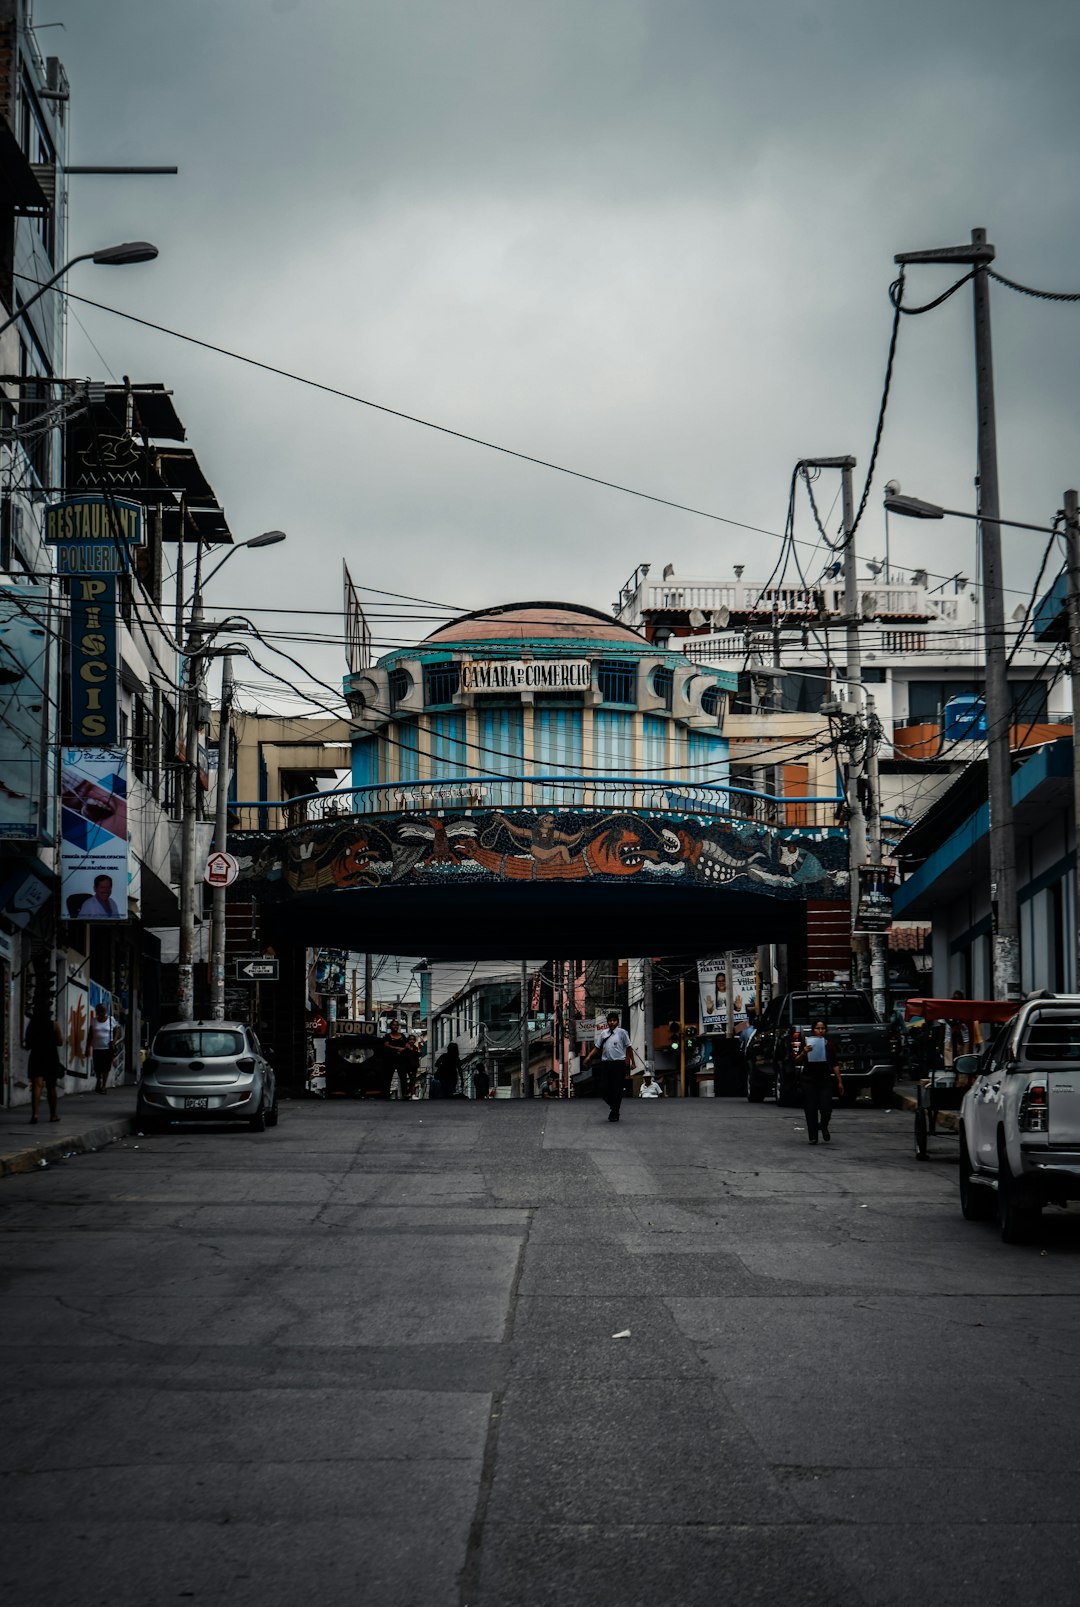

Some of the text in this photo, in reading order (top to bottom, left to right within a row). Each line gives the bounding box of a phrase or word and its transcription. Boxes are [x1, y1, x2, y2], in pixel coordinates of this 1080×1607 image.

[47, 503, 137, 538] RESTAURANT
[79, 579, 108, 737] PISCIS
[463, 665, 517, 688] CAMARA
[525, 664, 590, 687] COMERCIO
